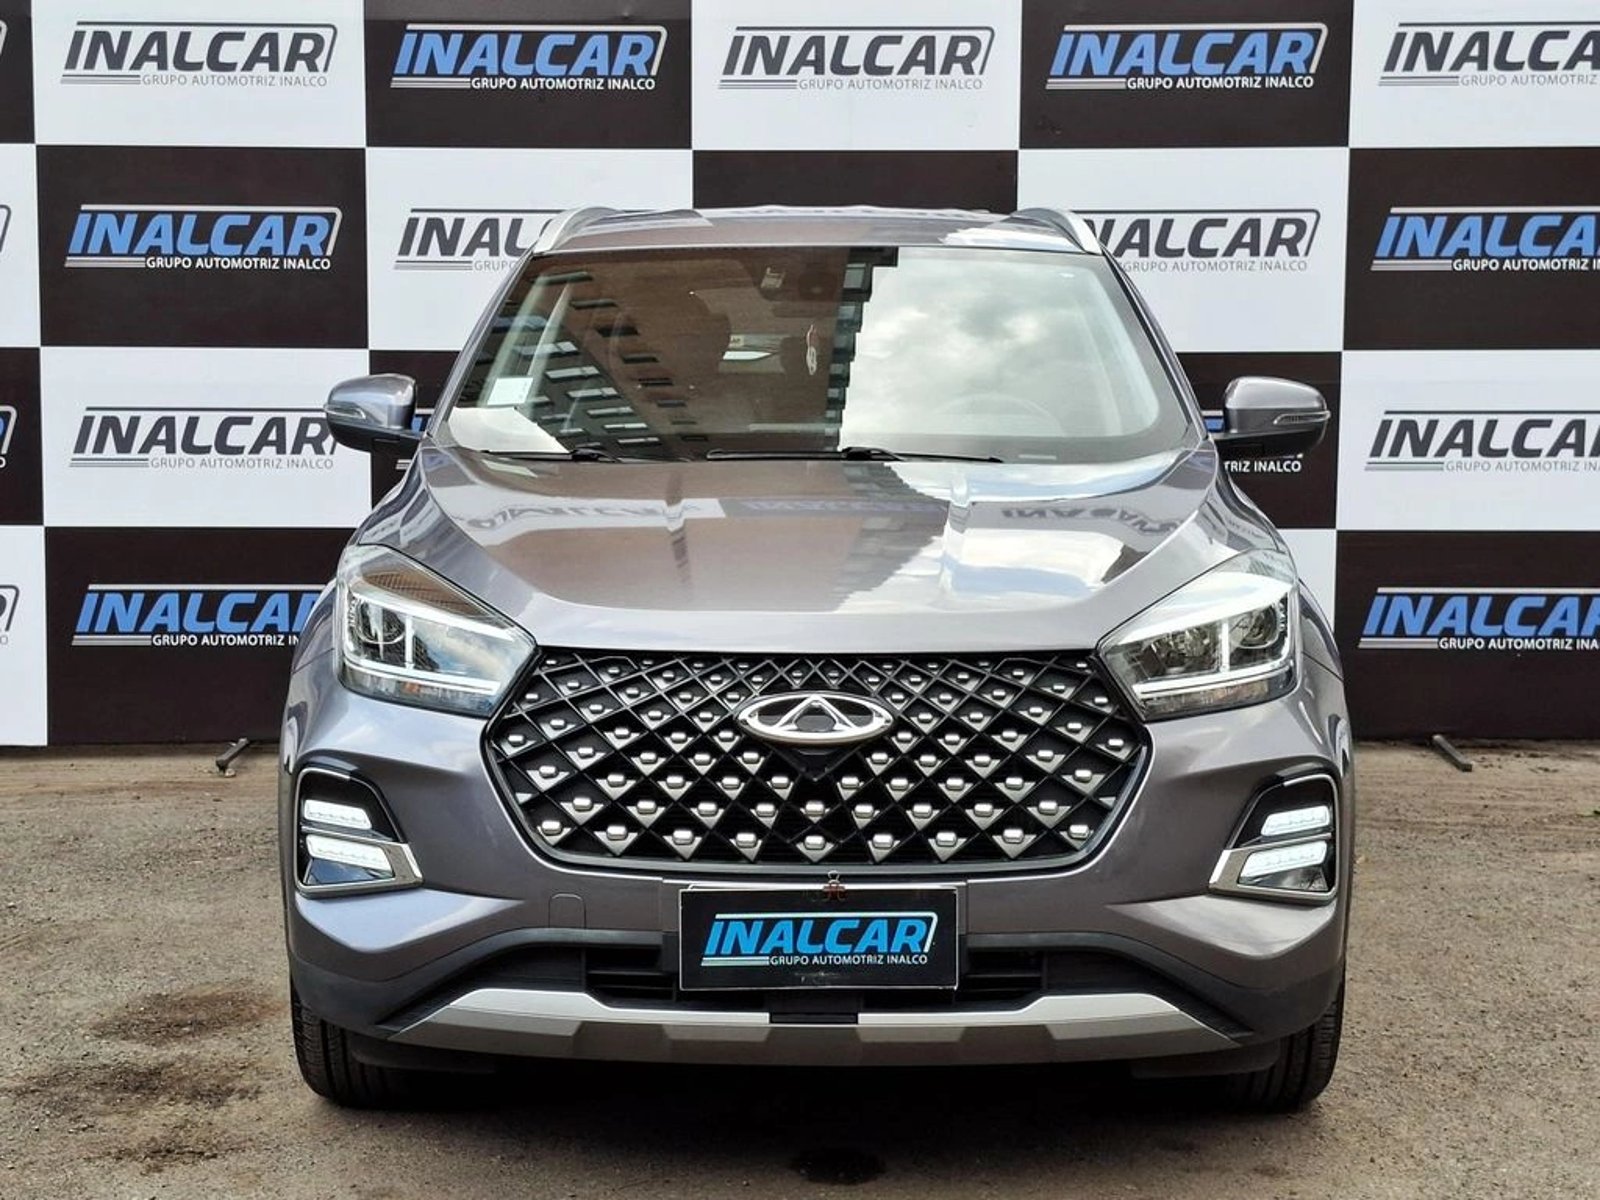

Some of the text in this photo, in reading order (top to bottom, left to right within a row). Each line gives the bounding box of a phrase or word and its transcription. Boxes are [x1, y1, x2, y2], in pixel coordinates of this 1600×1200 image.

[64, 30, 325, 72] INALCAR
[393, 33, 655, 76] INALCAR
[722, 35, 981, 76] INALCAR
[1050, 32, 1315, 75] INALCAR
[1384, 30, 1600, 71] INALCA
[142, 74, 327, 87] GRUPO AUTOMOTRIZ INALCO
[471, 77, 655, 91] GRUPO AUTOMOTRIZ INALCO
[799, 79, 983, 90] GRUPO AUTOMOTRIZ INALCO
[1127, 76, 1314, 90] GRUPO AUTOMOTRIZ INALCO
[1461, 75, 1597, 86] GRUPO AUTOMOTRIZ
[68, 213, 330, 255] INALCAR
[398, 217, 553, 257] INAL
[1083, 218, 1308, 258] ALCAR
[1376, 215, 1600, 258] INALCA
[146, 257, 331, 270] GRUPO AUTOMOTRIZ INALCO
[1123, 260, 1308, 272] GRUPO AUTOMOTRIZ INALCO
[1453, 259, 1499, 271] GRUPO
[1502, 259, 1589, 271] AUTOMOTRIZ
[73, 415, 330, 455] INALCAR
[151, 457, 333, 469] GRUPO AUTOMOTRIZ INALCO
[1254, 460, 1302, 472] INALCO
[1446, 462, 1492, 471] GRUPO
[1496, 461, 1580, 472] AUTOMOTRIZ
[152, 634, 198, 646] GRUPO
[201, 634, 285, 646] AUTOMOTRIZ
[1439, 638, 1600, 650] GRUPO AUTOMOTRIZ INA
[705, 919, 927, 955] INALCAR
[770, 954, 928, 965] GRUPO AUTOMOTRIZ INALCO
